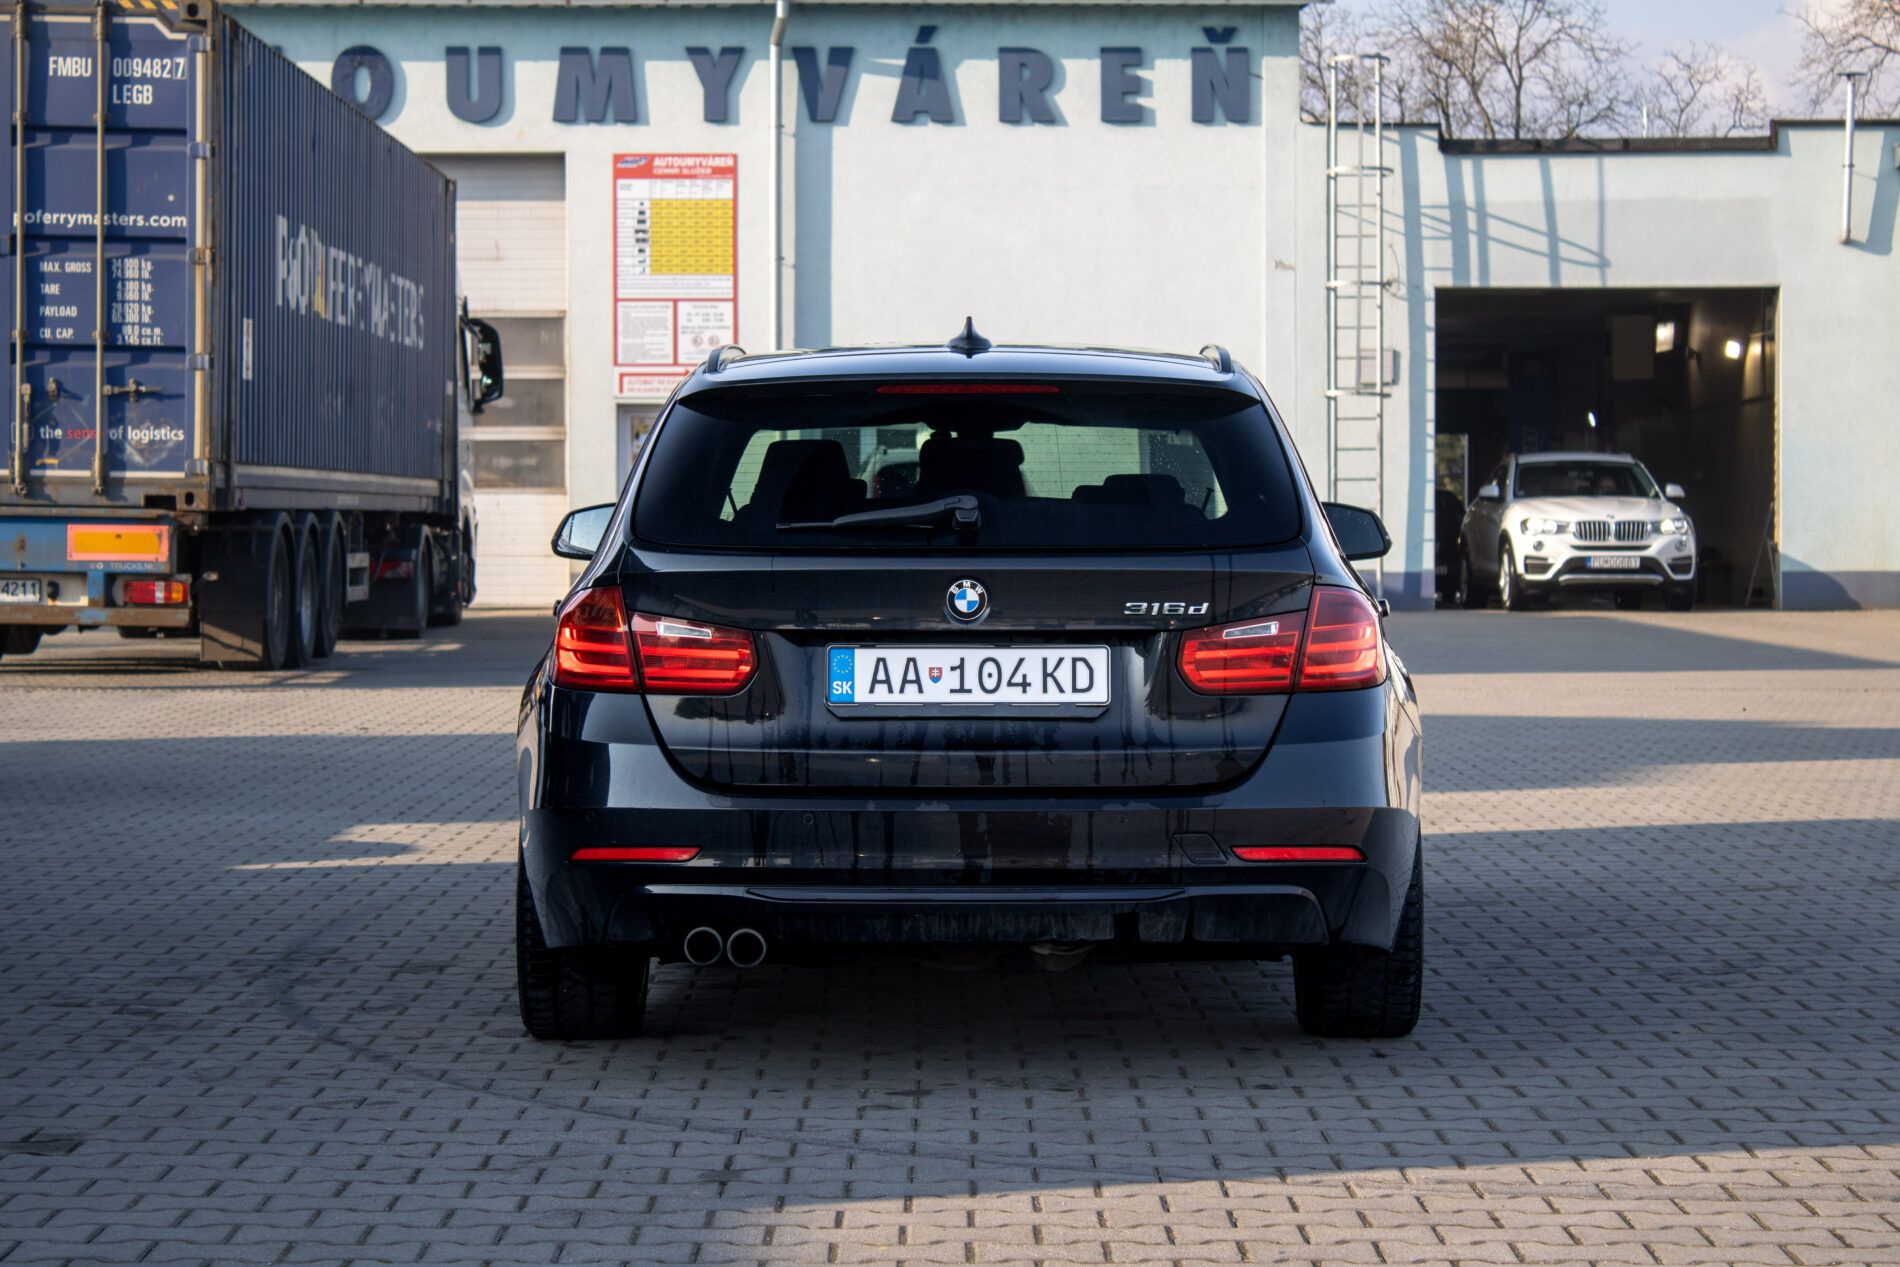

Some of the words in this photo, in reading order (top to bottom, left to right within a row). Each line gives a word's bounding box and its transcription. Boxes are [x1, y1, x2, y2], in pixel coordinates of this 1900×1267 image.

[49, 57, 92, 77] FMBU
[272, 24, 1249, 123] OUMYVÁREŇ
[112, 85, 153, 104] LEGB
[40, 261, 62, 273] MAX.
[65, 262, 92, 273] GROSS
[40, 284, 60, 295] TARE
[40, 306, 77, 317] PAYLOAD
[40, 328, 52, 339] CU.
[56, 328, 74, 339] CAP.
[40, 425, 62, 439] the
[66, 427, 98, 440] sens
[109, 425, 124, 440] of
[128, 425, 184, 444] logistics
[950, 581, 984, 594] BMW
[1123, 602, 1210, 615] 316d
[832, 681, 852, 694] SK
